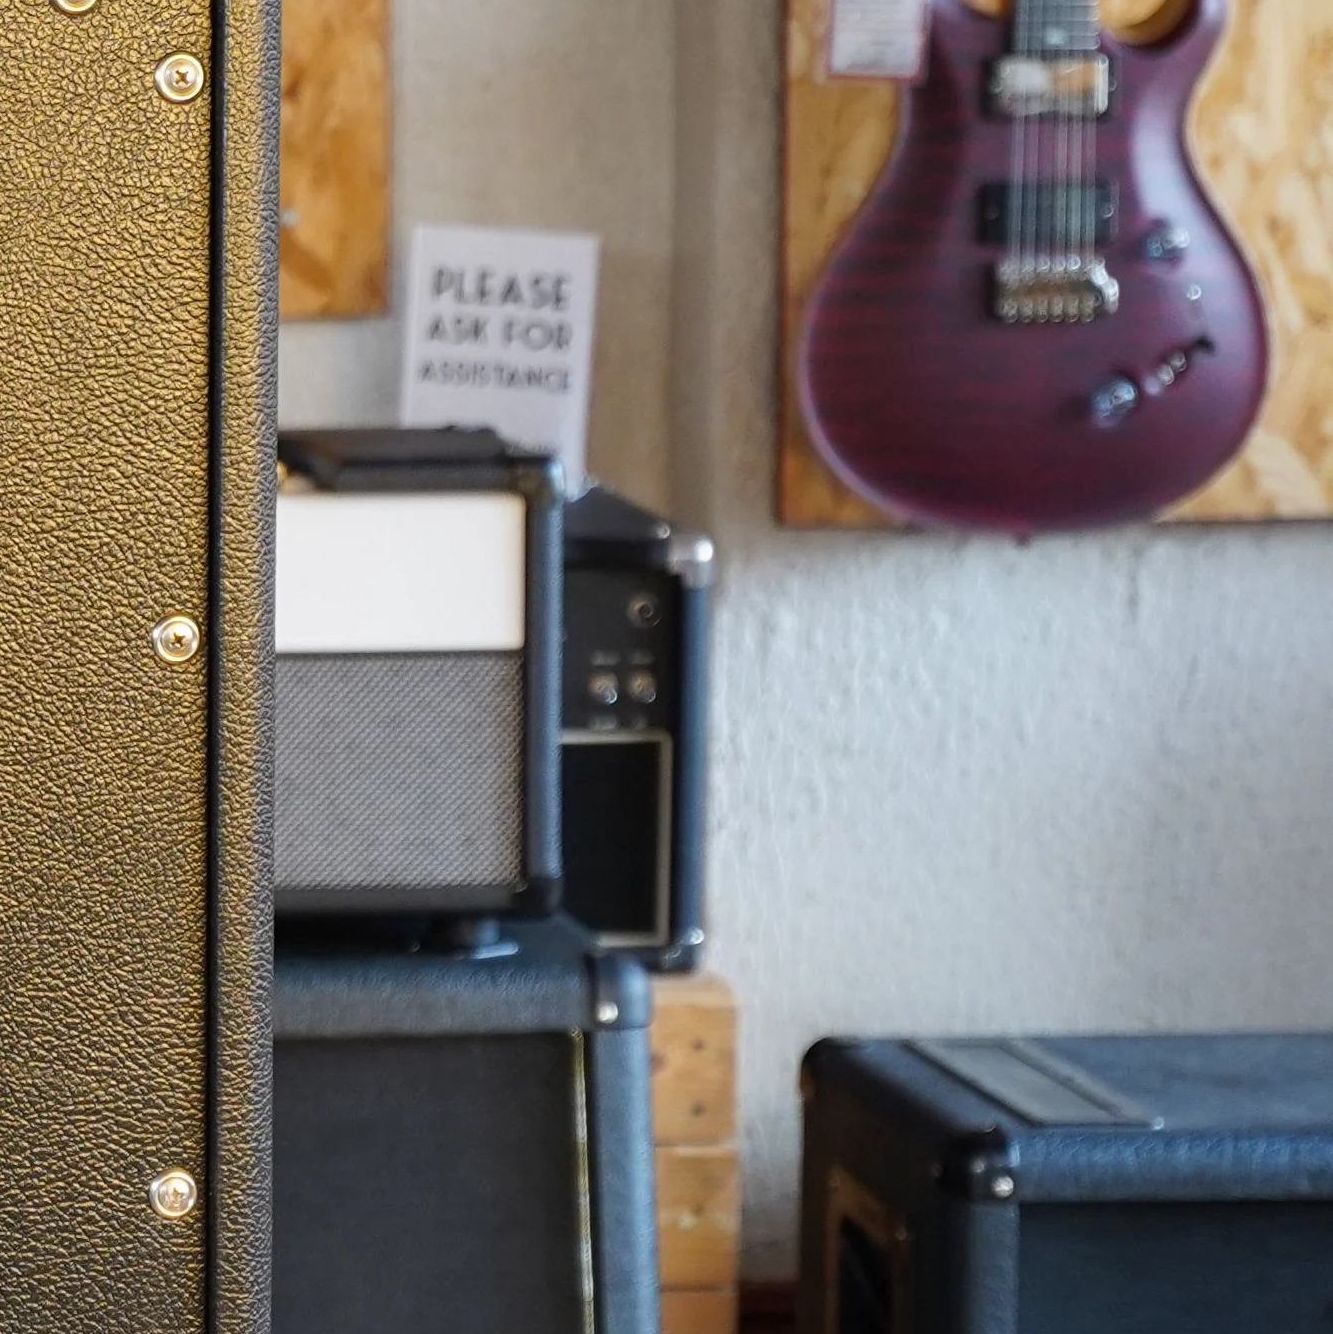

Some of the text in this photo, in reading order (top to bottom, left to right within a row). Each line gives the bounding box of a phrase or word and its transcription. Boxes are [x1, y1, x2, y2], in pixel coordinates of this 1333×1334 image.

[431, 265, 573, 312] PLEASE
[425, 317, 573, 352] ASK FOR
[418, 362, 573, 395] ASSISTANCE
